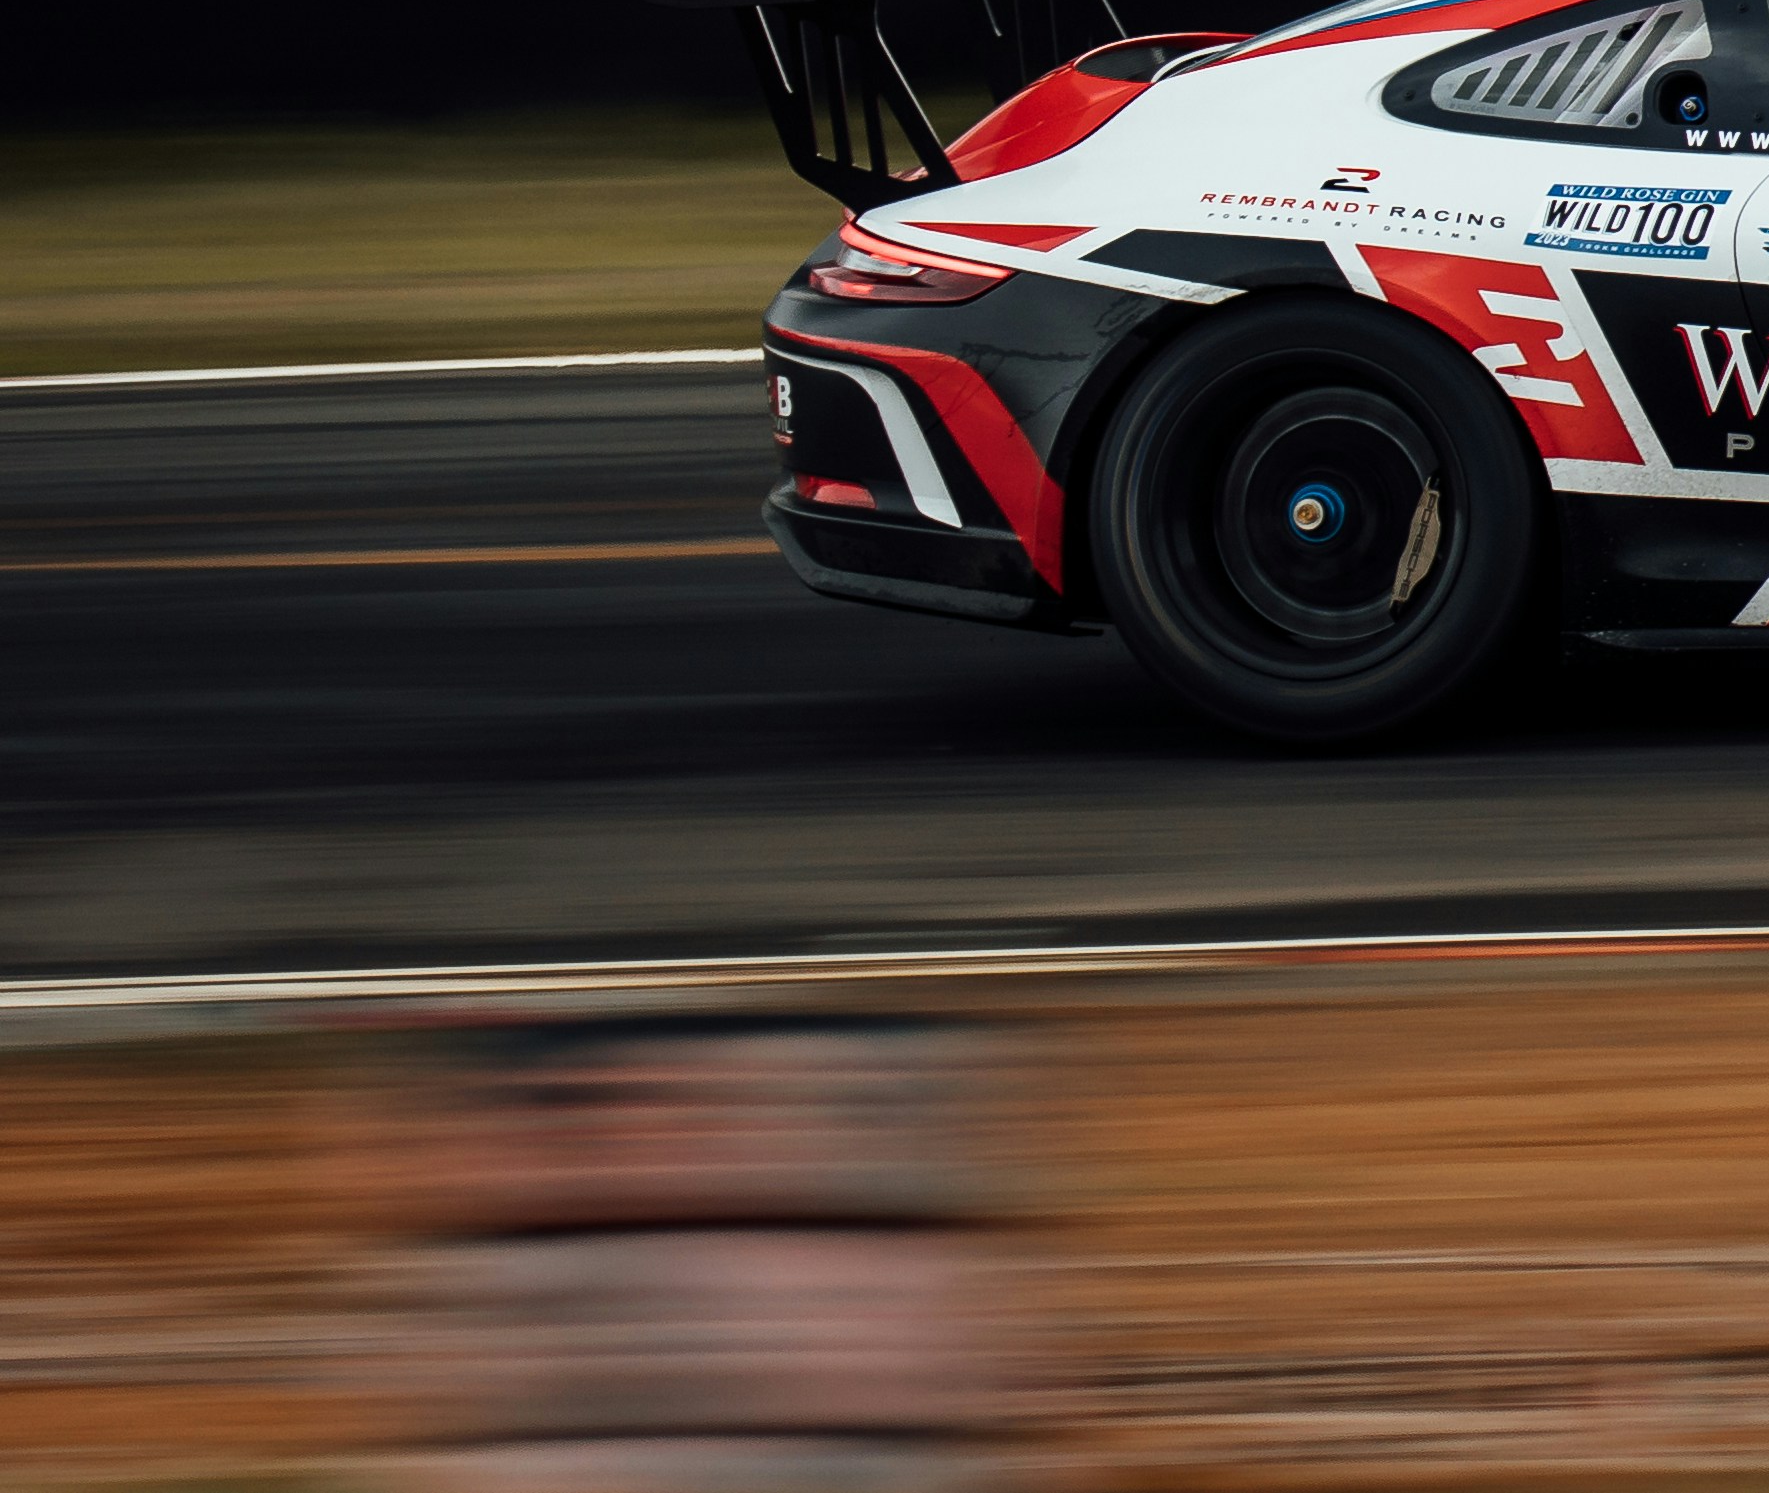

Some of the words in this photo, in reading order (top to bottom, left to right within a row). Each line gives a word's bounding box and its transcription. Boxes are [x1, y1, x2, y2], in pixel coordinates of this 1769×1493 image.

[1562, 186, 1616, 199] WILD
[1620, 188, 1675, 200] ROSE
[1681, 189, 1720, 202] GIN
[1200, 193, 1380, 215] REMBRANDT
[1389, 206, 1506, 229] RACING
[1207, 213, 1309, 224] POWERED
[1383, 225, 1476, 241] DREAMS
[1534, 232, 1571, 247] 2023
[1399, 492, 1437, 598] PORSCHE
